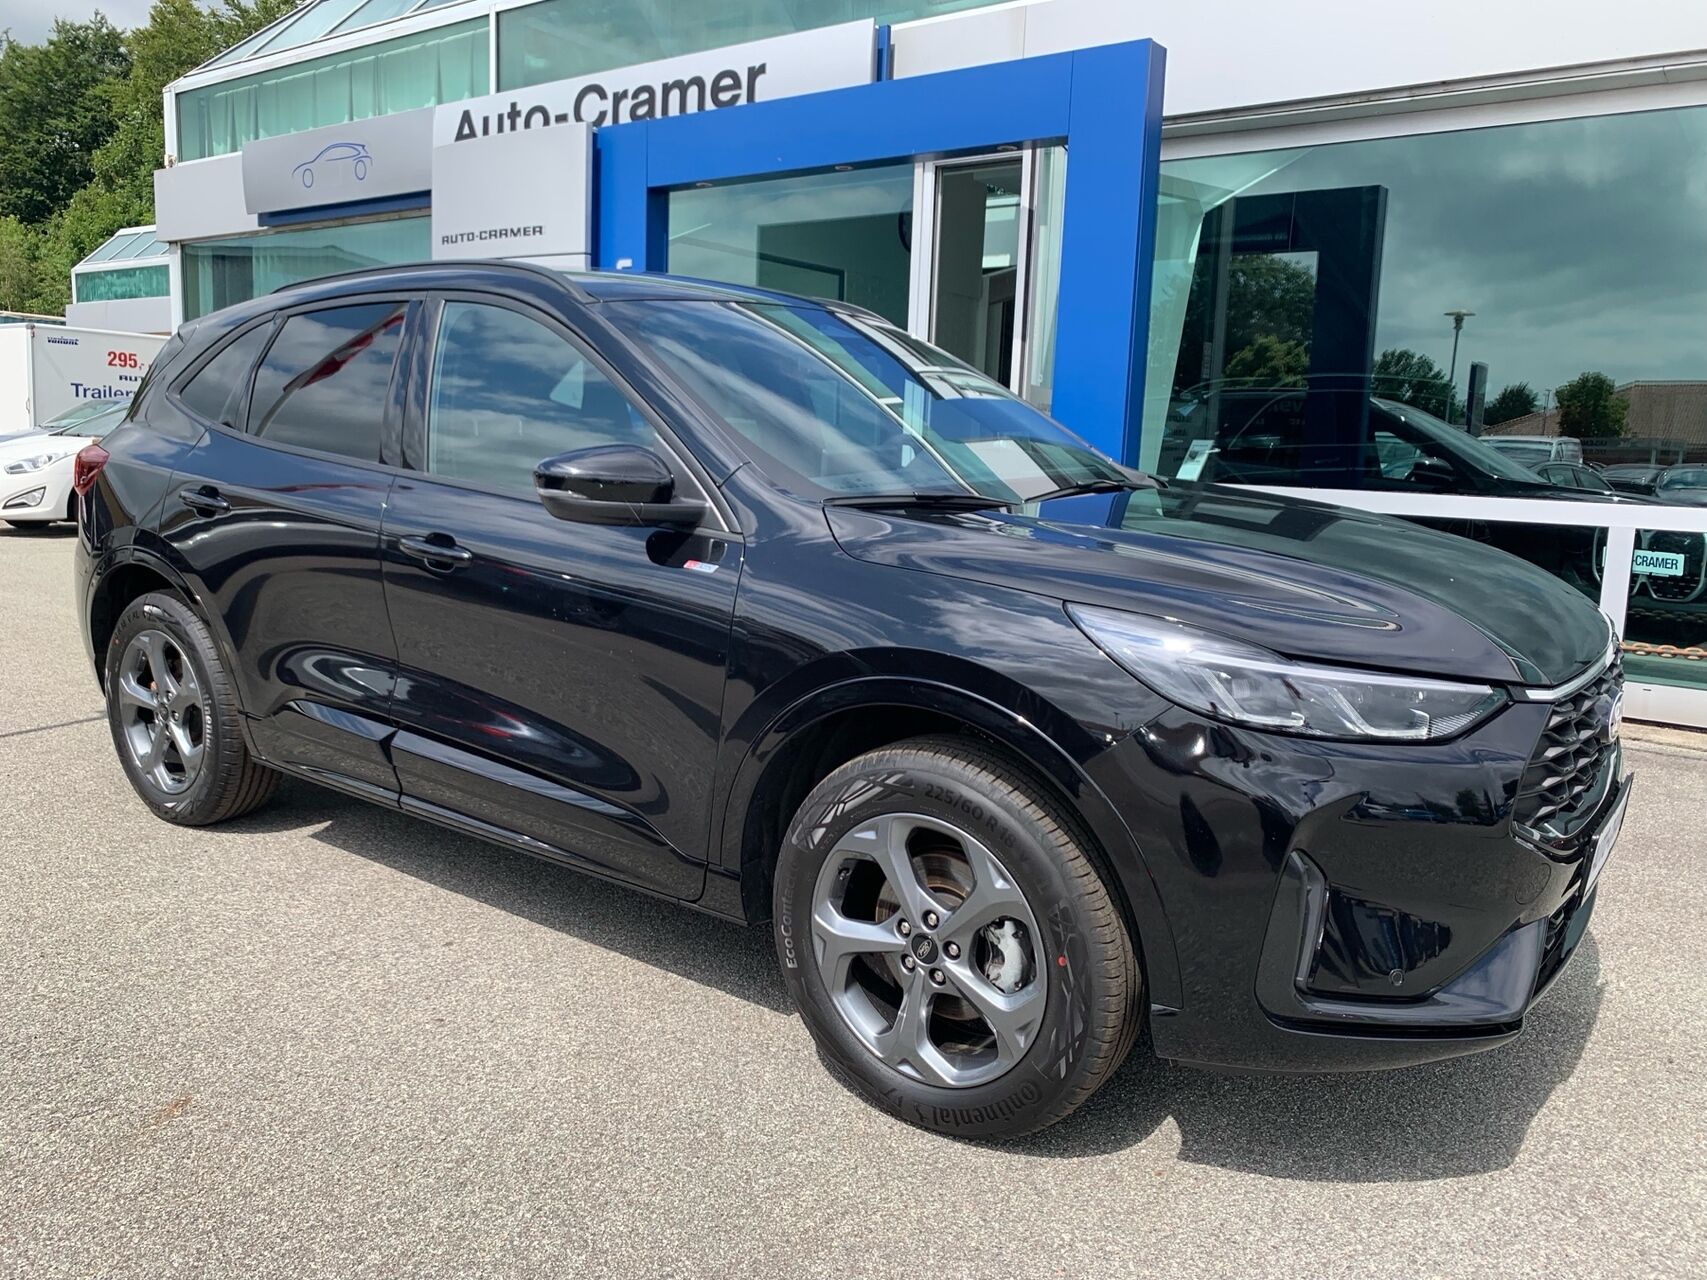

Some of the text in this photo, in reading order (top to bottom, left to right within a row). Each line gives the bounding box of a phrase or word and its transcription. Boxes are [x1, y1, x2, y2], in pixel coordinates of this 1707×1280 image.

[453, 62, 767, 142] Auto-Cramer
[70, 382, 137, 399] Trailer
[924, 783, 985, 821] 225/60
[932, 1079, 1044, 1128] Continental
